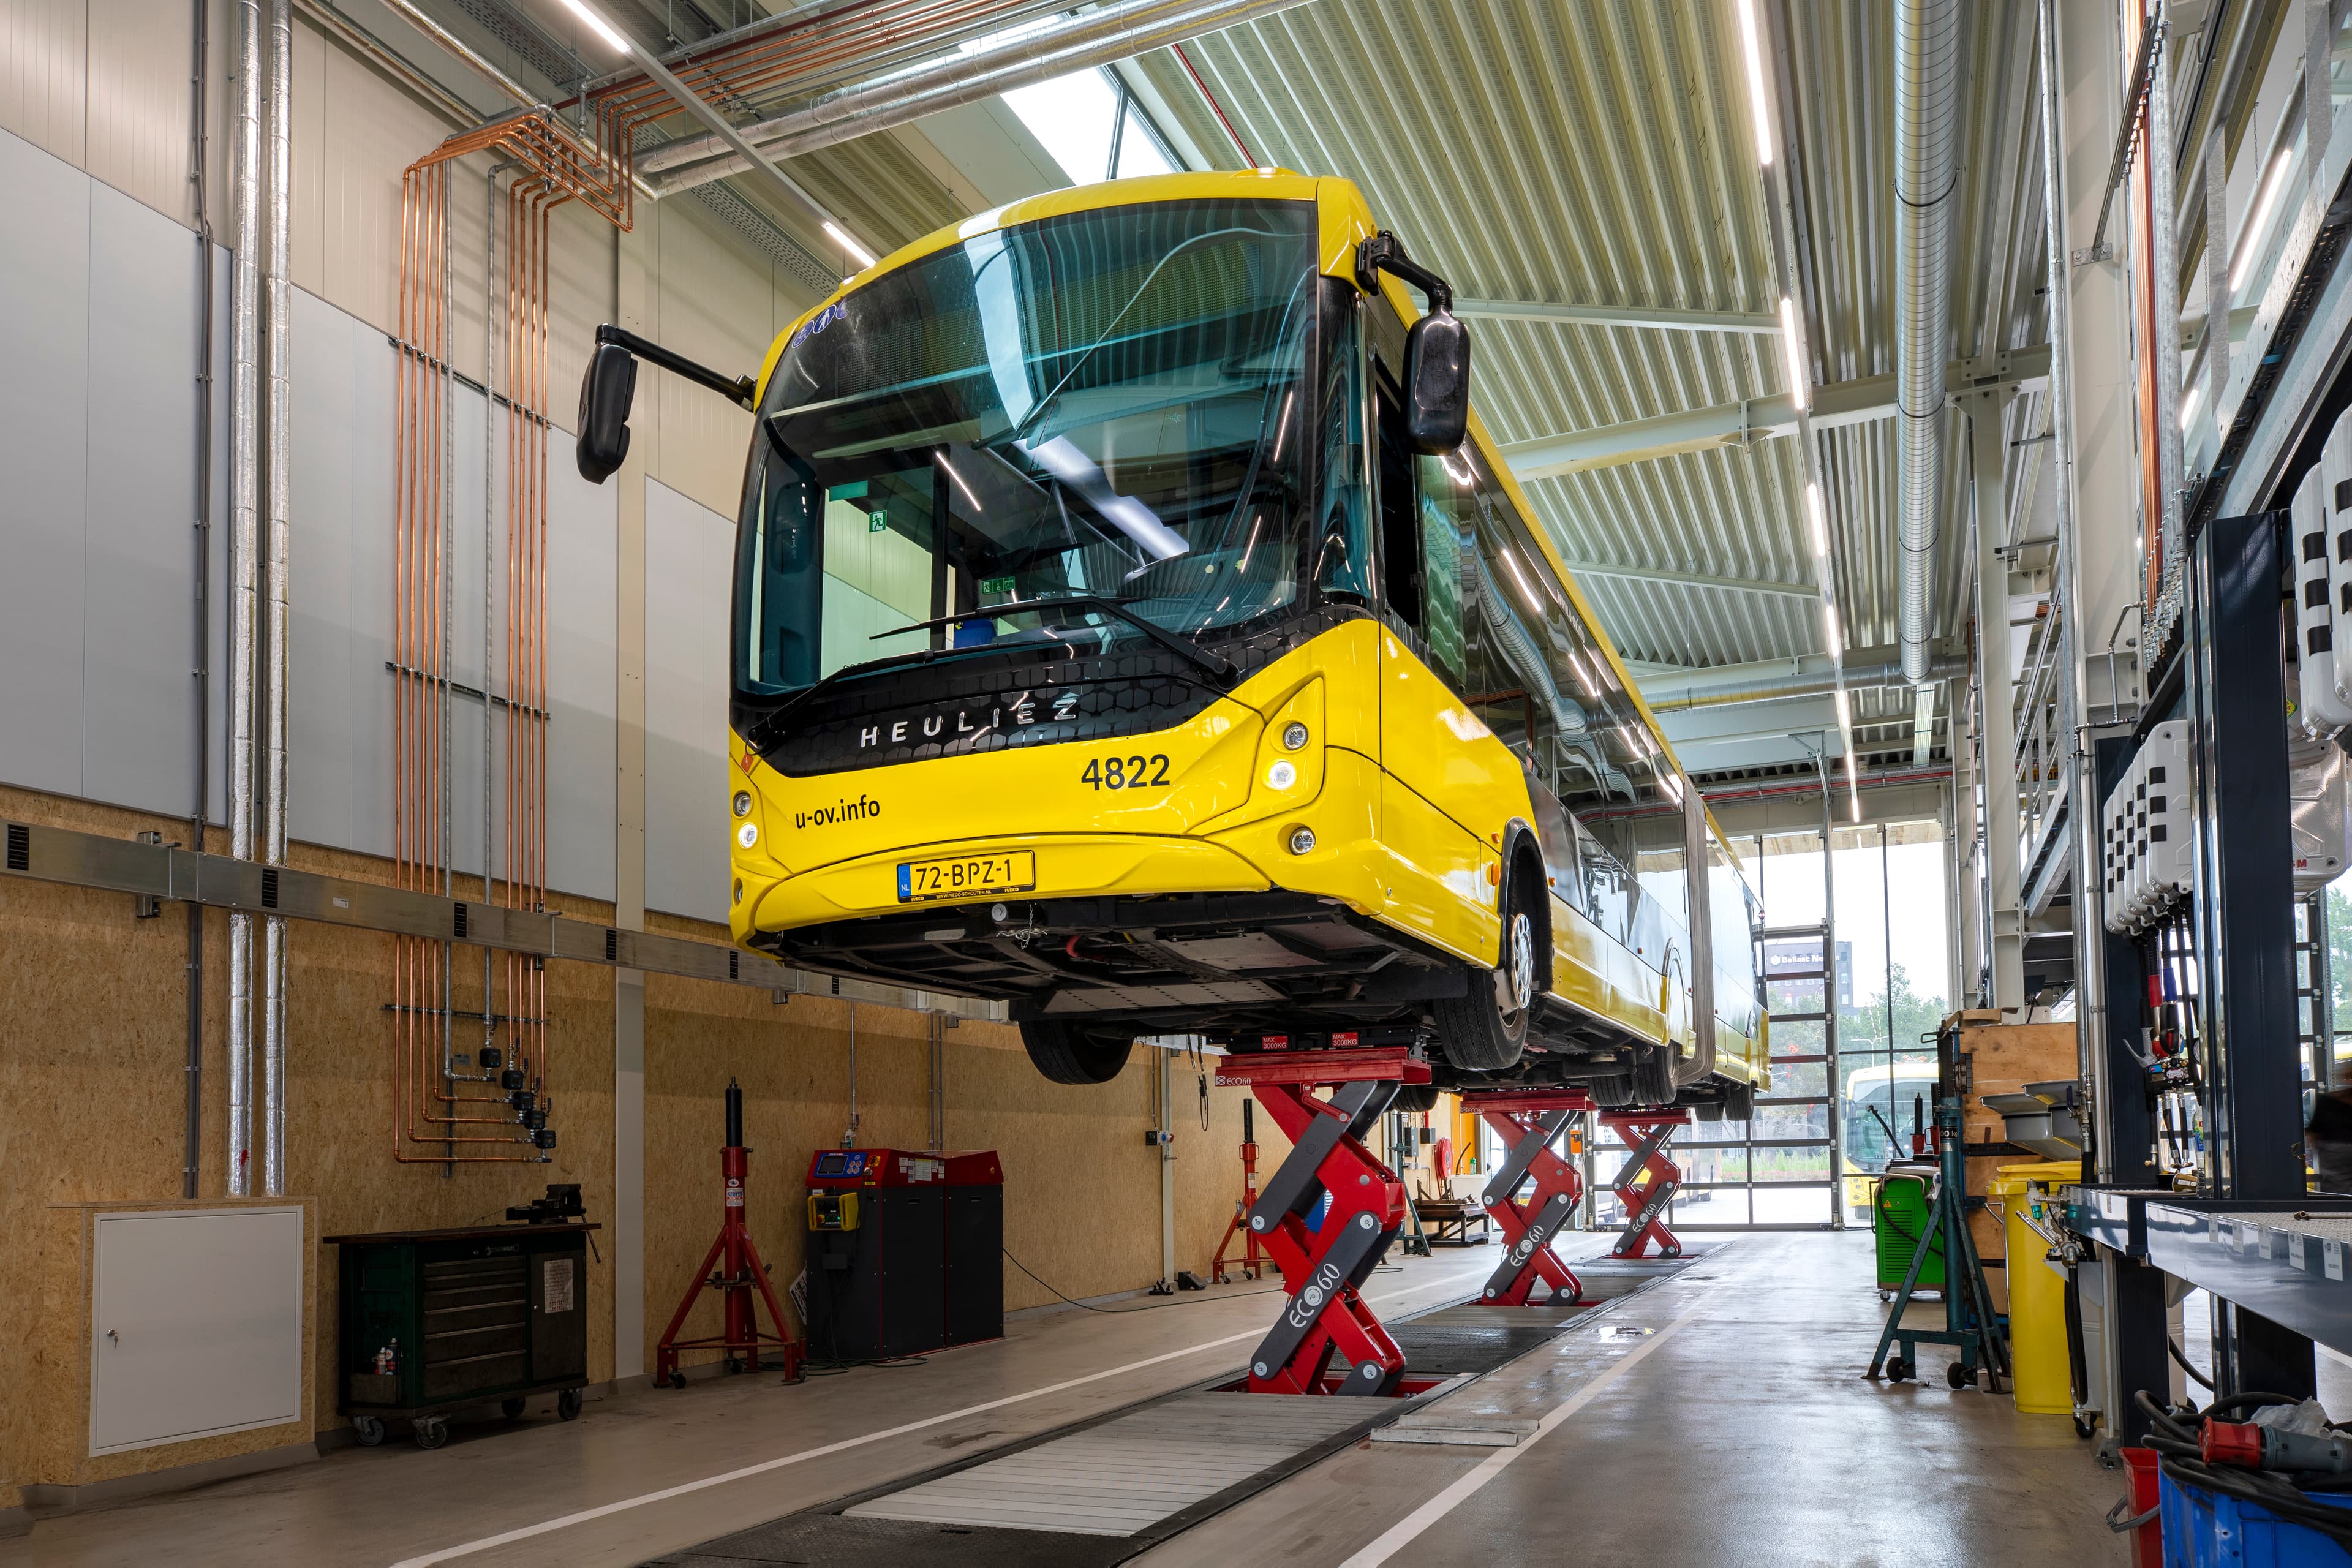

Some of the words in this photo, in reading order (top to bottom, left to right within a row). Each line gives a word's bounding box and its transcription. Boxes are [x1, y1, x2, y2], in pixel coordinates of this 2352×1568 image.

[860, 699, 1077, 748] HEULIEZ
[1080, 753, 1170, 791] 4822
[795, 794, 880, 829] u-ov.info
[916, 858, 1011, 891] 72-BPZ-1
[1632, 1203, 1657, 1232] ECO60
[1510, 1225, 1544, 1267] ECO60
[1289, 1264, 1340, 1328] ECO60
